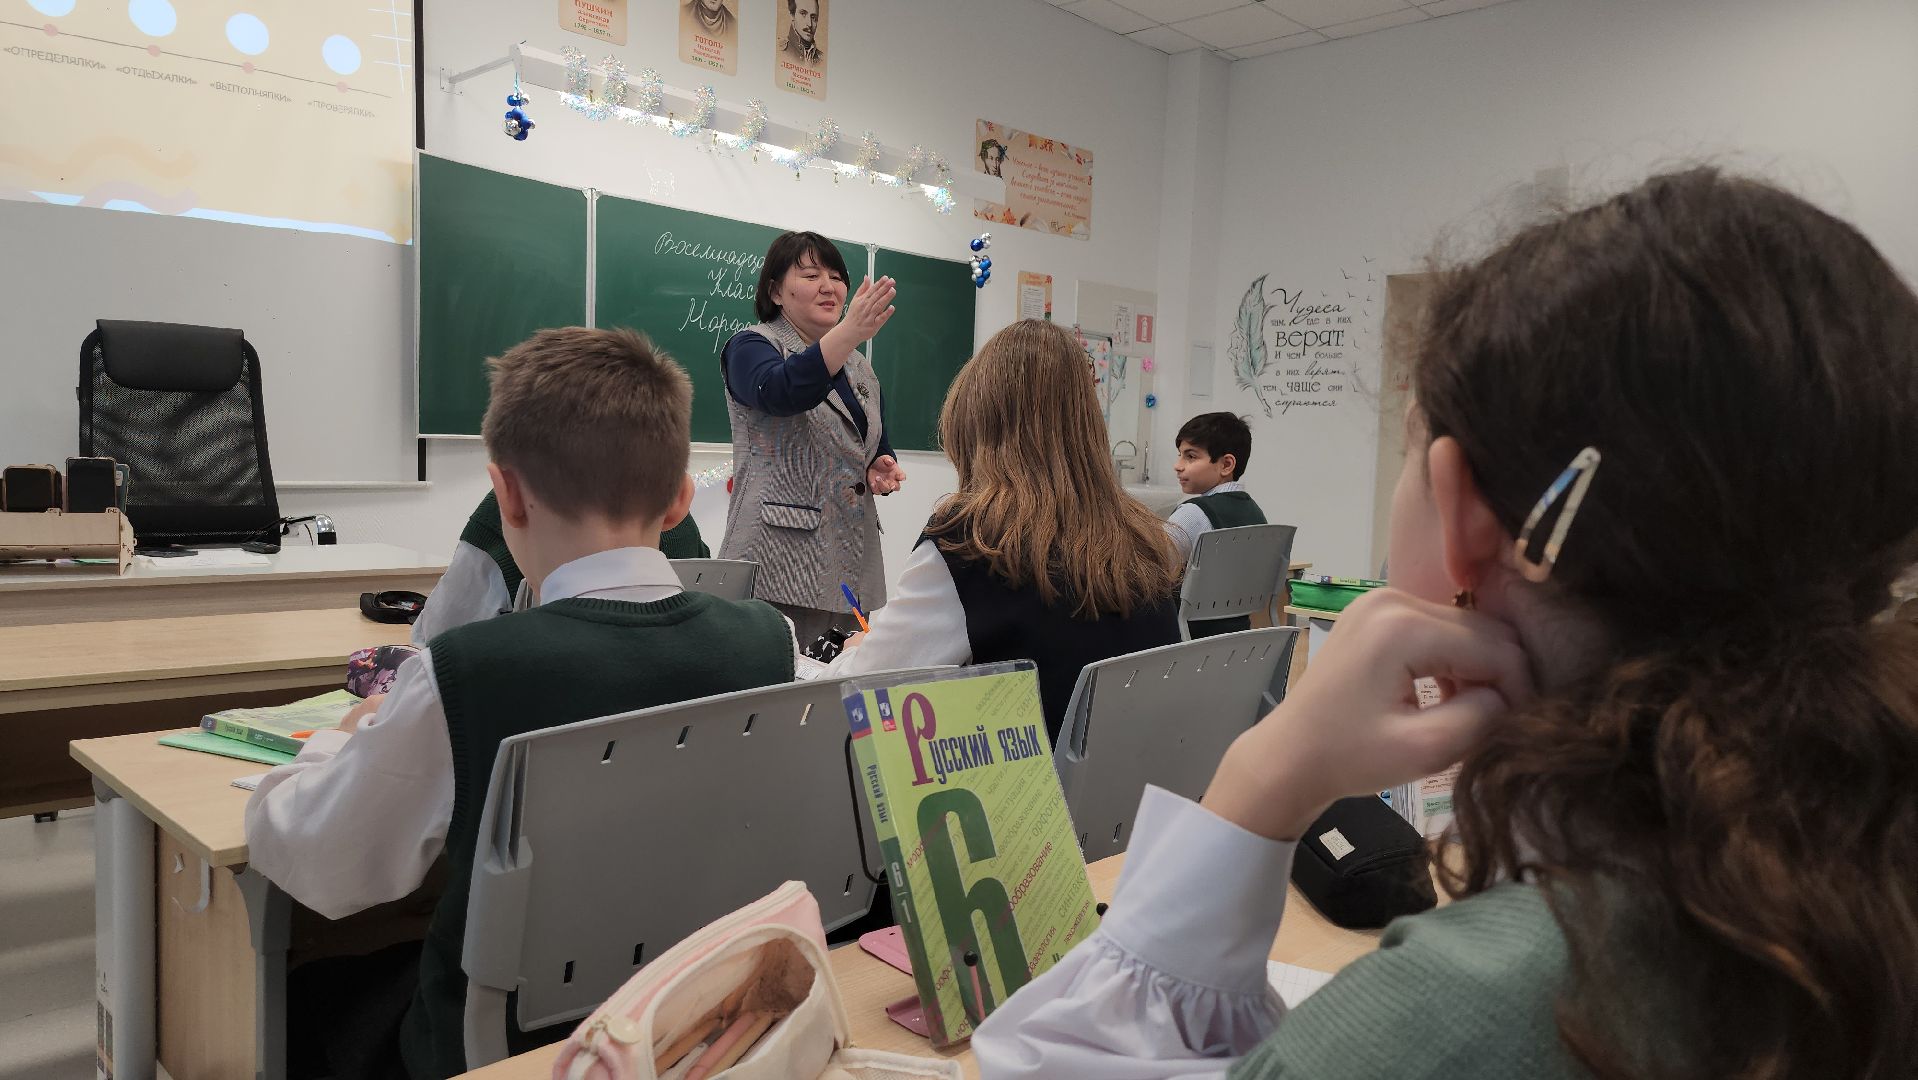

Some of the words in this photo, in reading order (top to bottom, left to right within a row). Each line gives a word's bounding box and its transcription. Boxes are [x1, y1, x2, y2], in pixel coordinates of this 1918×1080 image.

[695, 35, 724, 49] ГОГОЛЬ
[115, 66, 198, 85] «ОТДЫХАЛКИ»
[1271, 288, 1346, 326] Чудеса
[1337, 316, 1352, 324] них
[1286, 352, 1301, 360] чем
[1314, 351, 1343, 359] больше
[1263, 384, 1277, 392] тем
[1286, 381, 1321, 393] чаще
[1327, 384, 1343, 392] они
[901, 692, 994, 788] Русский
[1010, 841, 1053, 912] ообразование
[916, 787, 1033, 1030] 6
